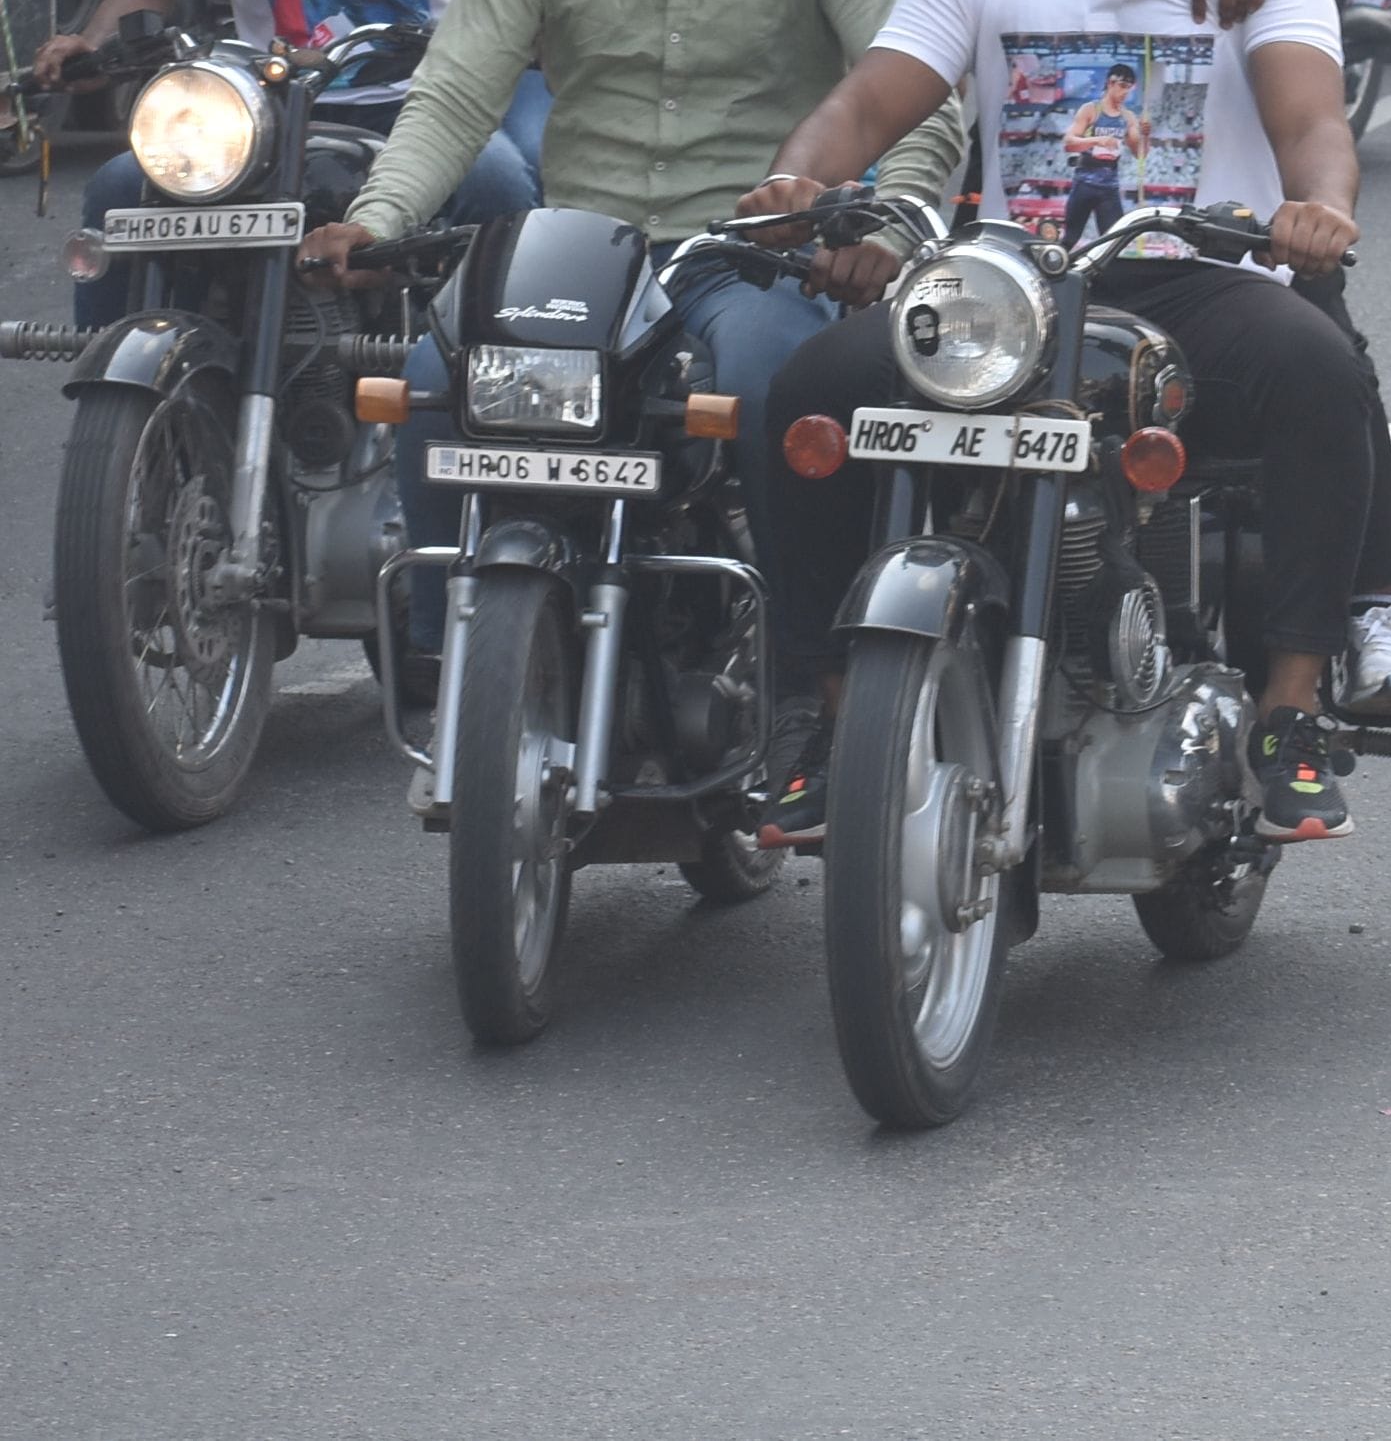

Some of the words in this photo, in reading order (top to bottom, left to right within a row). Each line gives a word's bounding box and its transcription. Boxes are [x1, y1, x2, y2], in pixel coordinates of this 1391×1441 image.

[854, 419, 921, 453] HR06
[950, 426, 986, 457] AE
[1015, 429, 1079, 463] 6478
[458, 453, 530, 479] HR06
[575, 458, 648, 485] 6642
